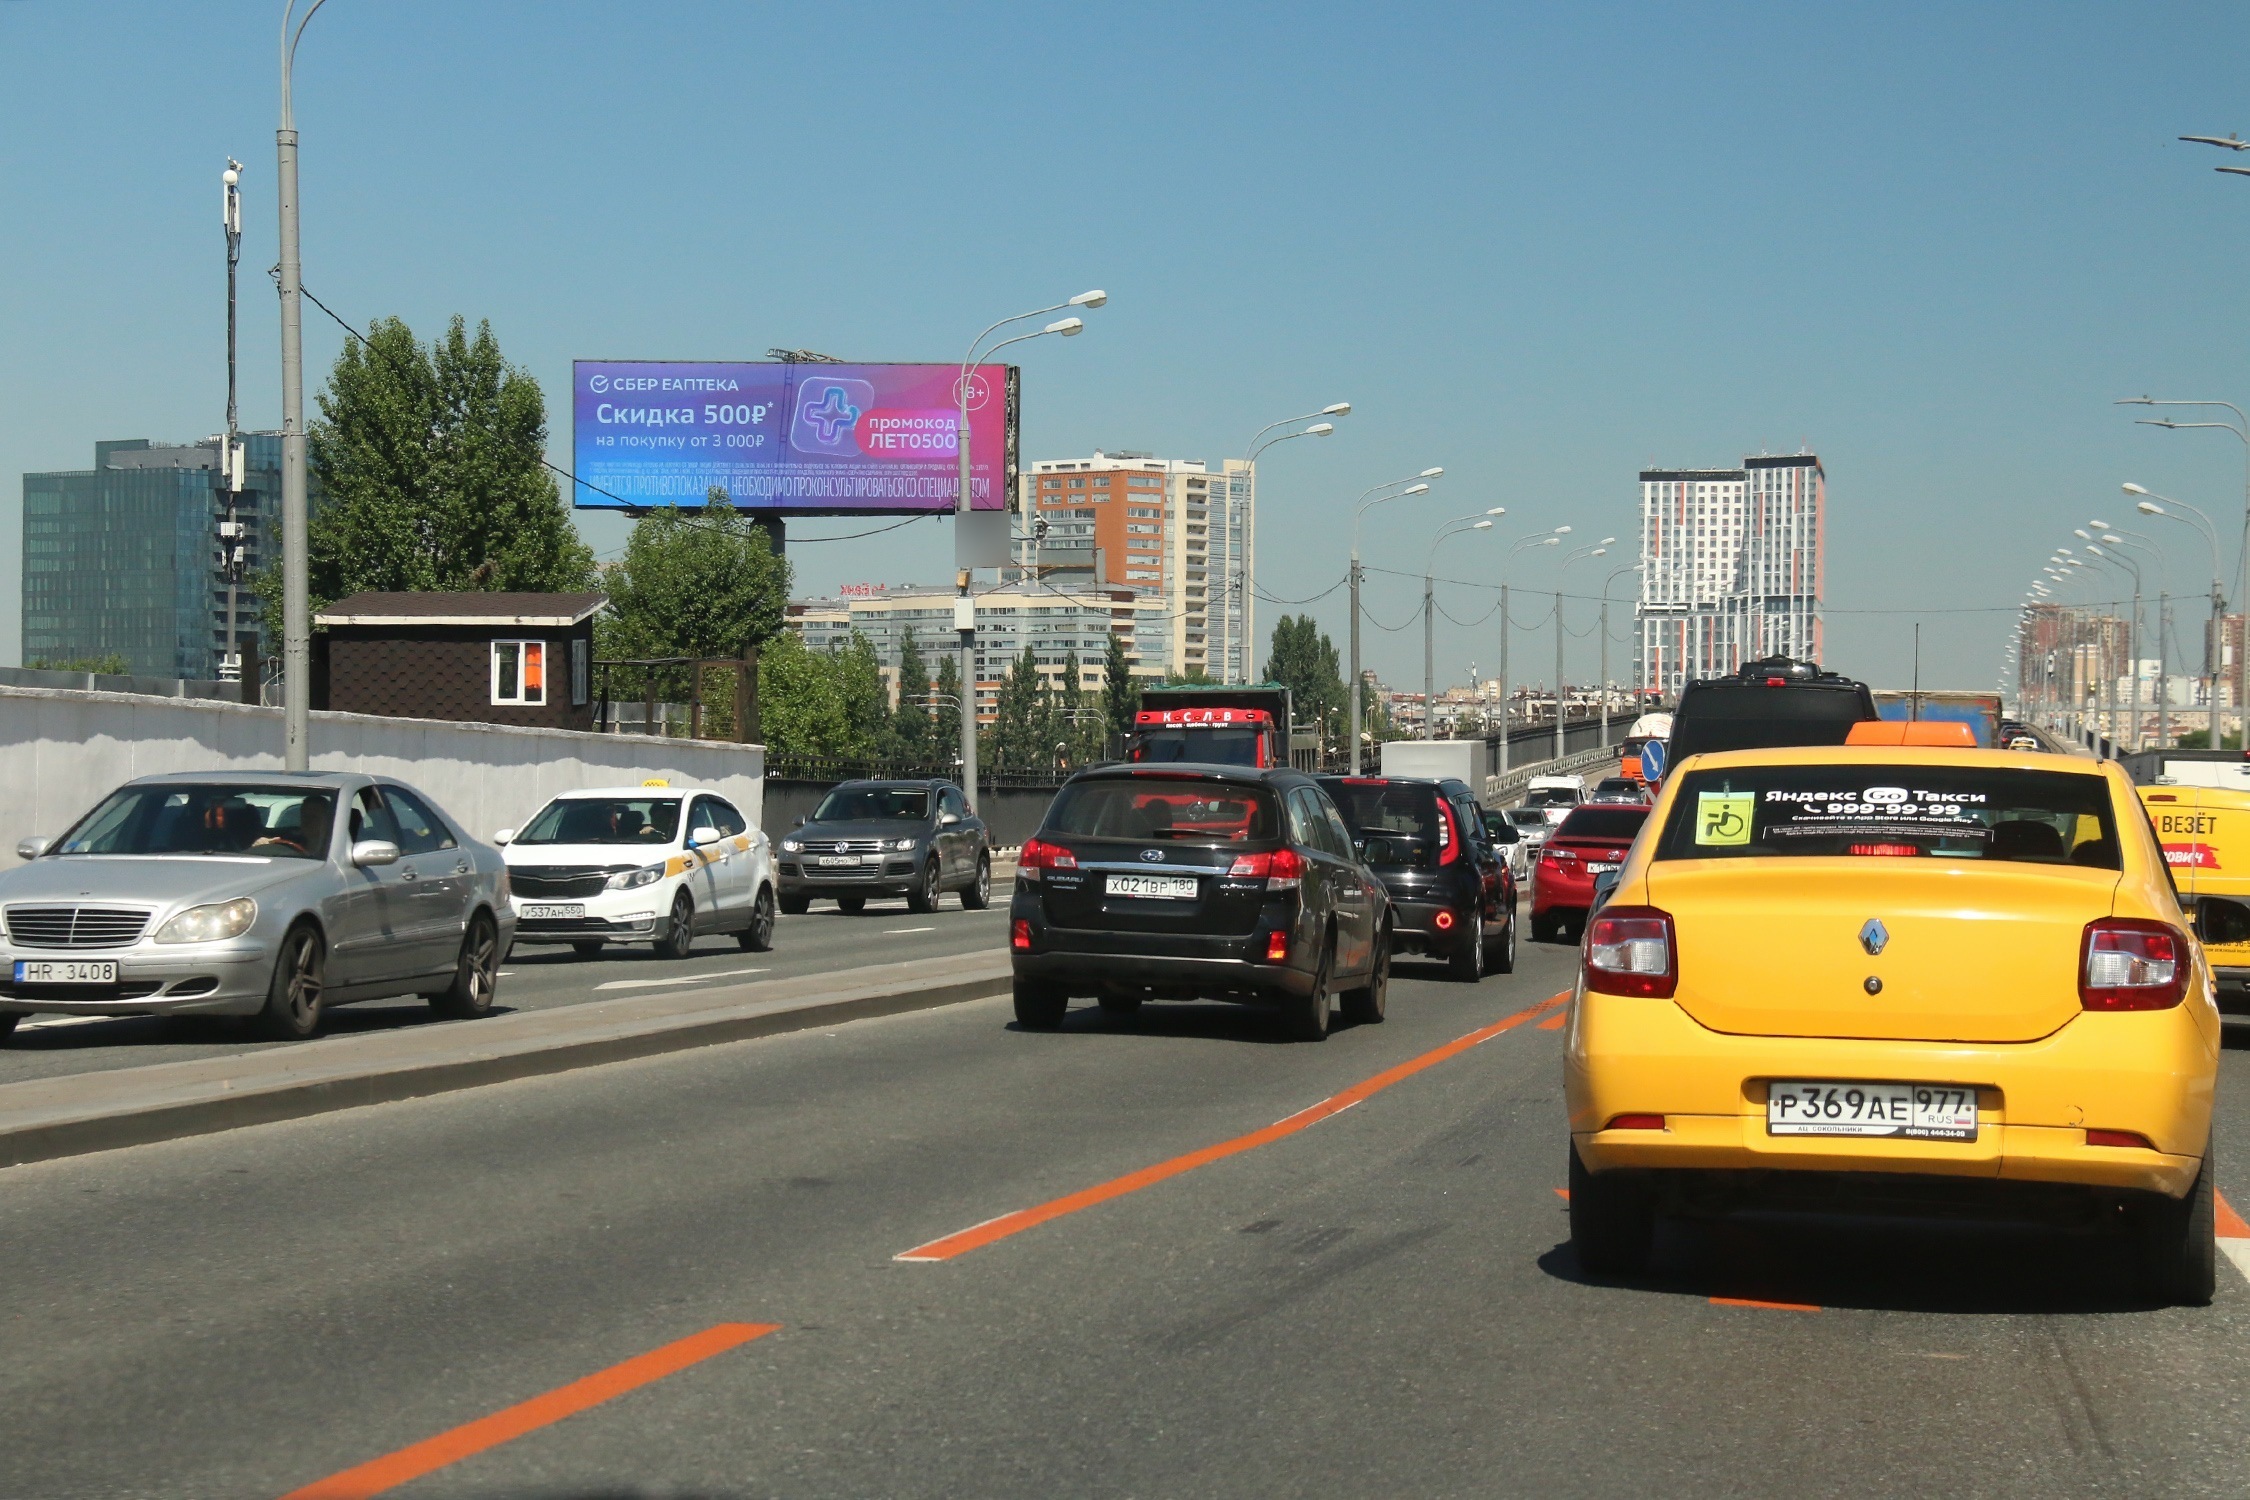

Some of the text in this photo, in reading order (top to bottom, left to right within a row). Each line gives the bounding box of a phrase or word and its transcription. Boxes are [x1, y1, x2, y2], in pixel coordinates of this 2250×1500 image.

[613, 378, 739, 391] СБЕР ЕАПТЕКА
[597, 403, 694, 427] Скидка
[869, 418, 956, 432] промокод
[596, 436, 614, 447] на
[620, 436, 685, 450] покупку
[691, 436, 707, 447] от
[713, 435, 721, 447] 3
[590, 475, 632, 496] ИМЕЮТСЯ
[731, 476, 790, 500] НЕОБХОДИМО
[793, 477, 904, 498] ПРОКОНСУЛЬТИРОВАТЬСЯ
[905, 478, 917, 498] СО
[1765, 790, 1857, 803] Яндекс
[1912, 790, 1986, 803] Такси
[1826, 803, 1961, 816] 999-99-99
[2162, 812, 2217, 834] ВЕЗЁТ
[1111, 877, 1194, 894] Х021ВР 180
[524, 907, 581, 917] У537АН 550
[1780, 1088, 1967, 1120] Р369АЕ 977
[1928, 1115, 1953, 1124] RUS
